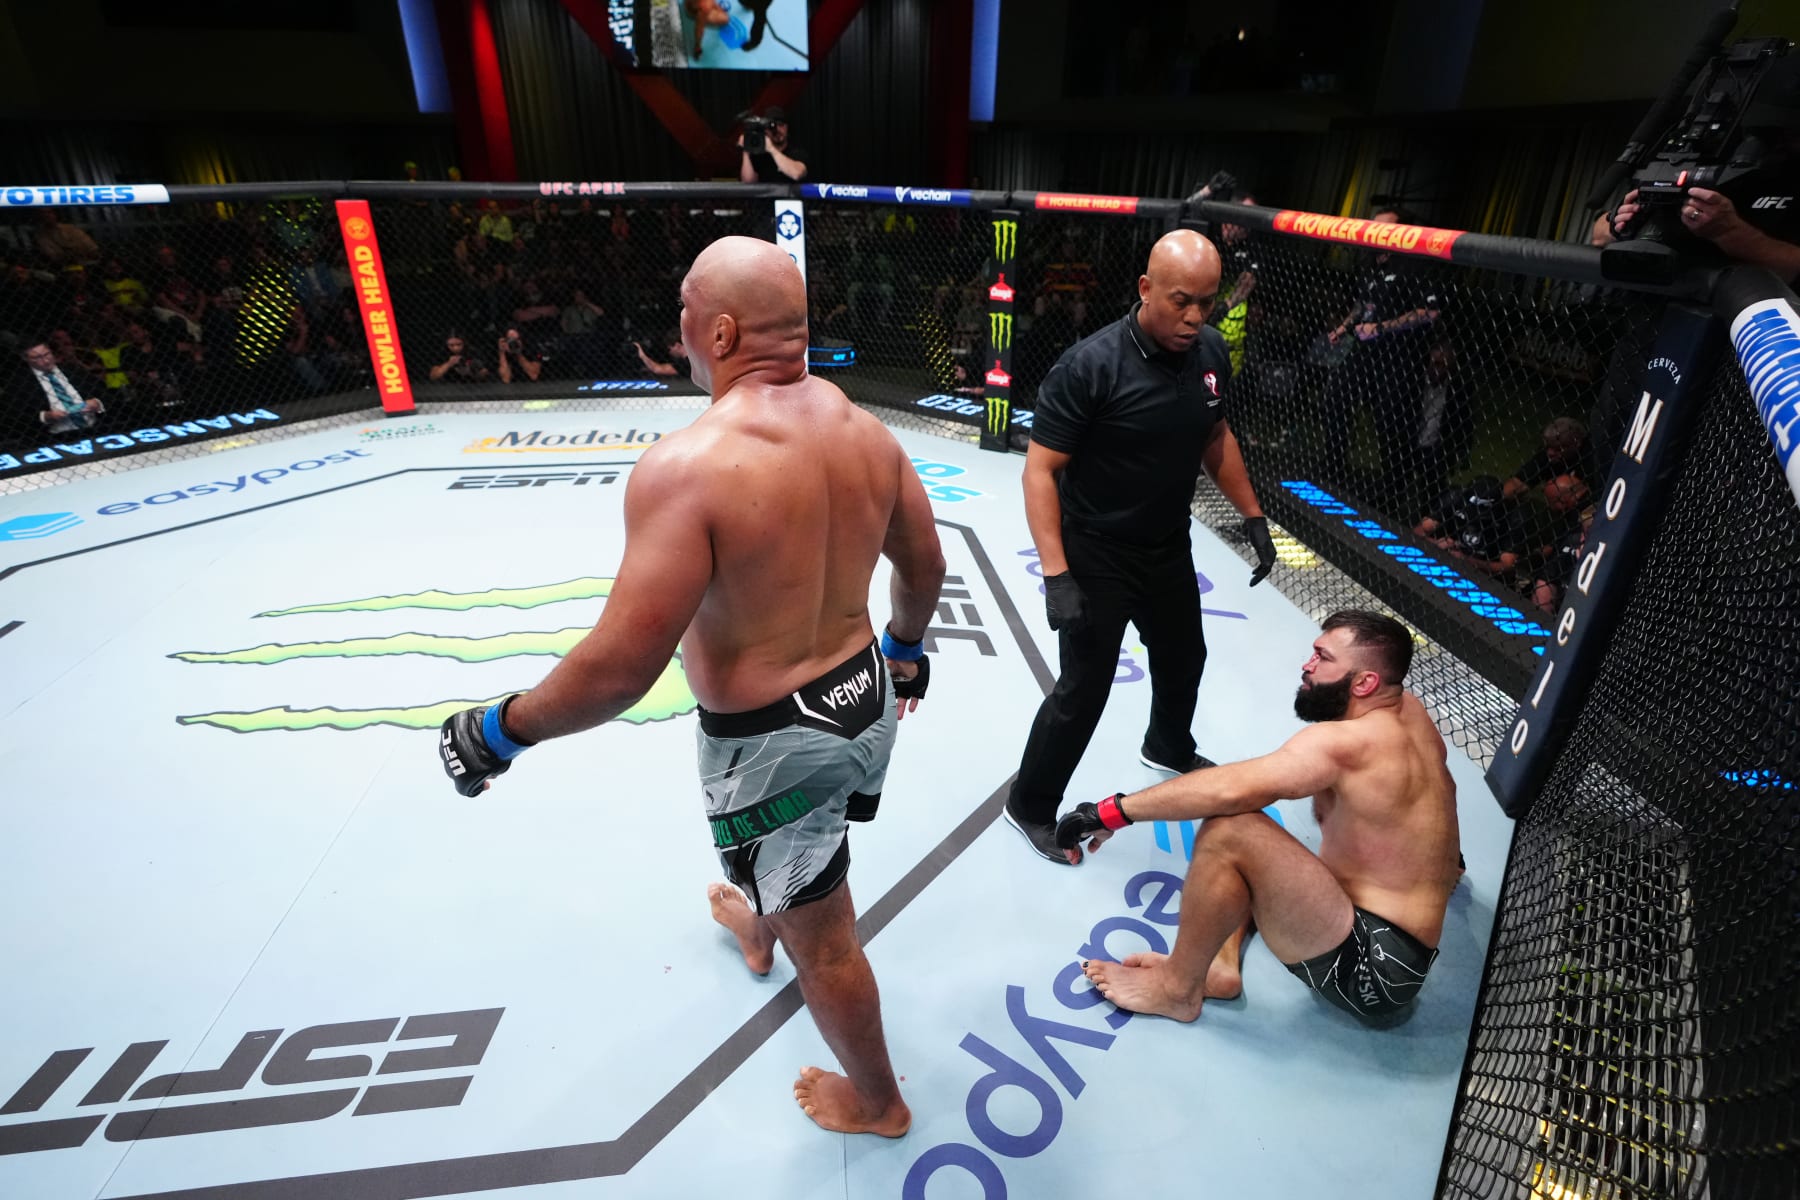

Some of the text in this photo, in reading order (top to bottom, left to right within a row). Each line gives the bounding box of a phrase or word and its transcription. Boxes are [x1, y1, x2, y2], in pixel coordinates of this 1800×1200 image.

[37, 186, 135, 204] TIRES
[539, 182, 626, 195] UFC APEX
[1049, 196, 1121, 210] HOWLER HEAD
[1751, 196, 1794, 209] UFC
[1292, 212, 1423, 251] HOWLER HEAD
[353, 245, 404, 394] HOWLER HEAD
[1647, 357, 1682, 385] CERVEZA
[497, 429, 661, 447] Modelo
[97, 447, 372, 516] easypost
[447, 471, 620, 490] ESPN
[1511, 391, 1664, 755] Modelo
[821, 667, 873, 711] VENUM
[441, 728, 466, 777] UFC
[732, 812, 761, 839] DE
[758, 790, 814, 830] LIMA
